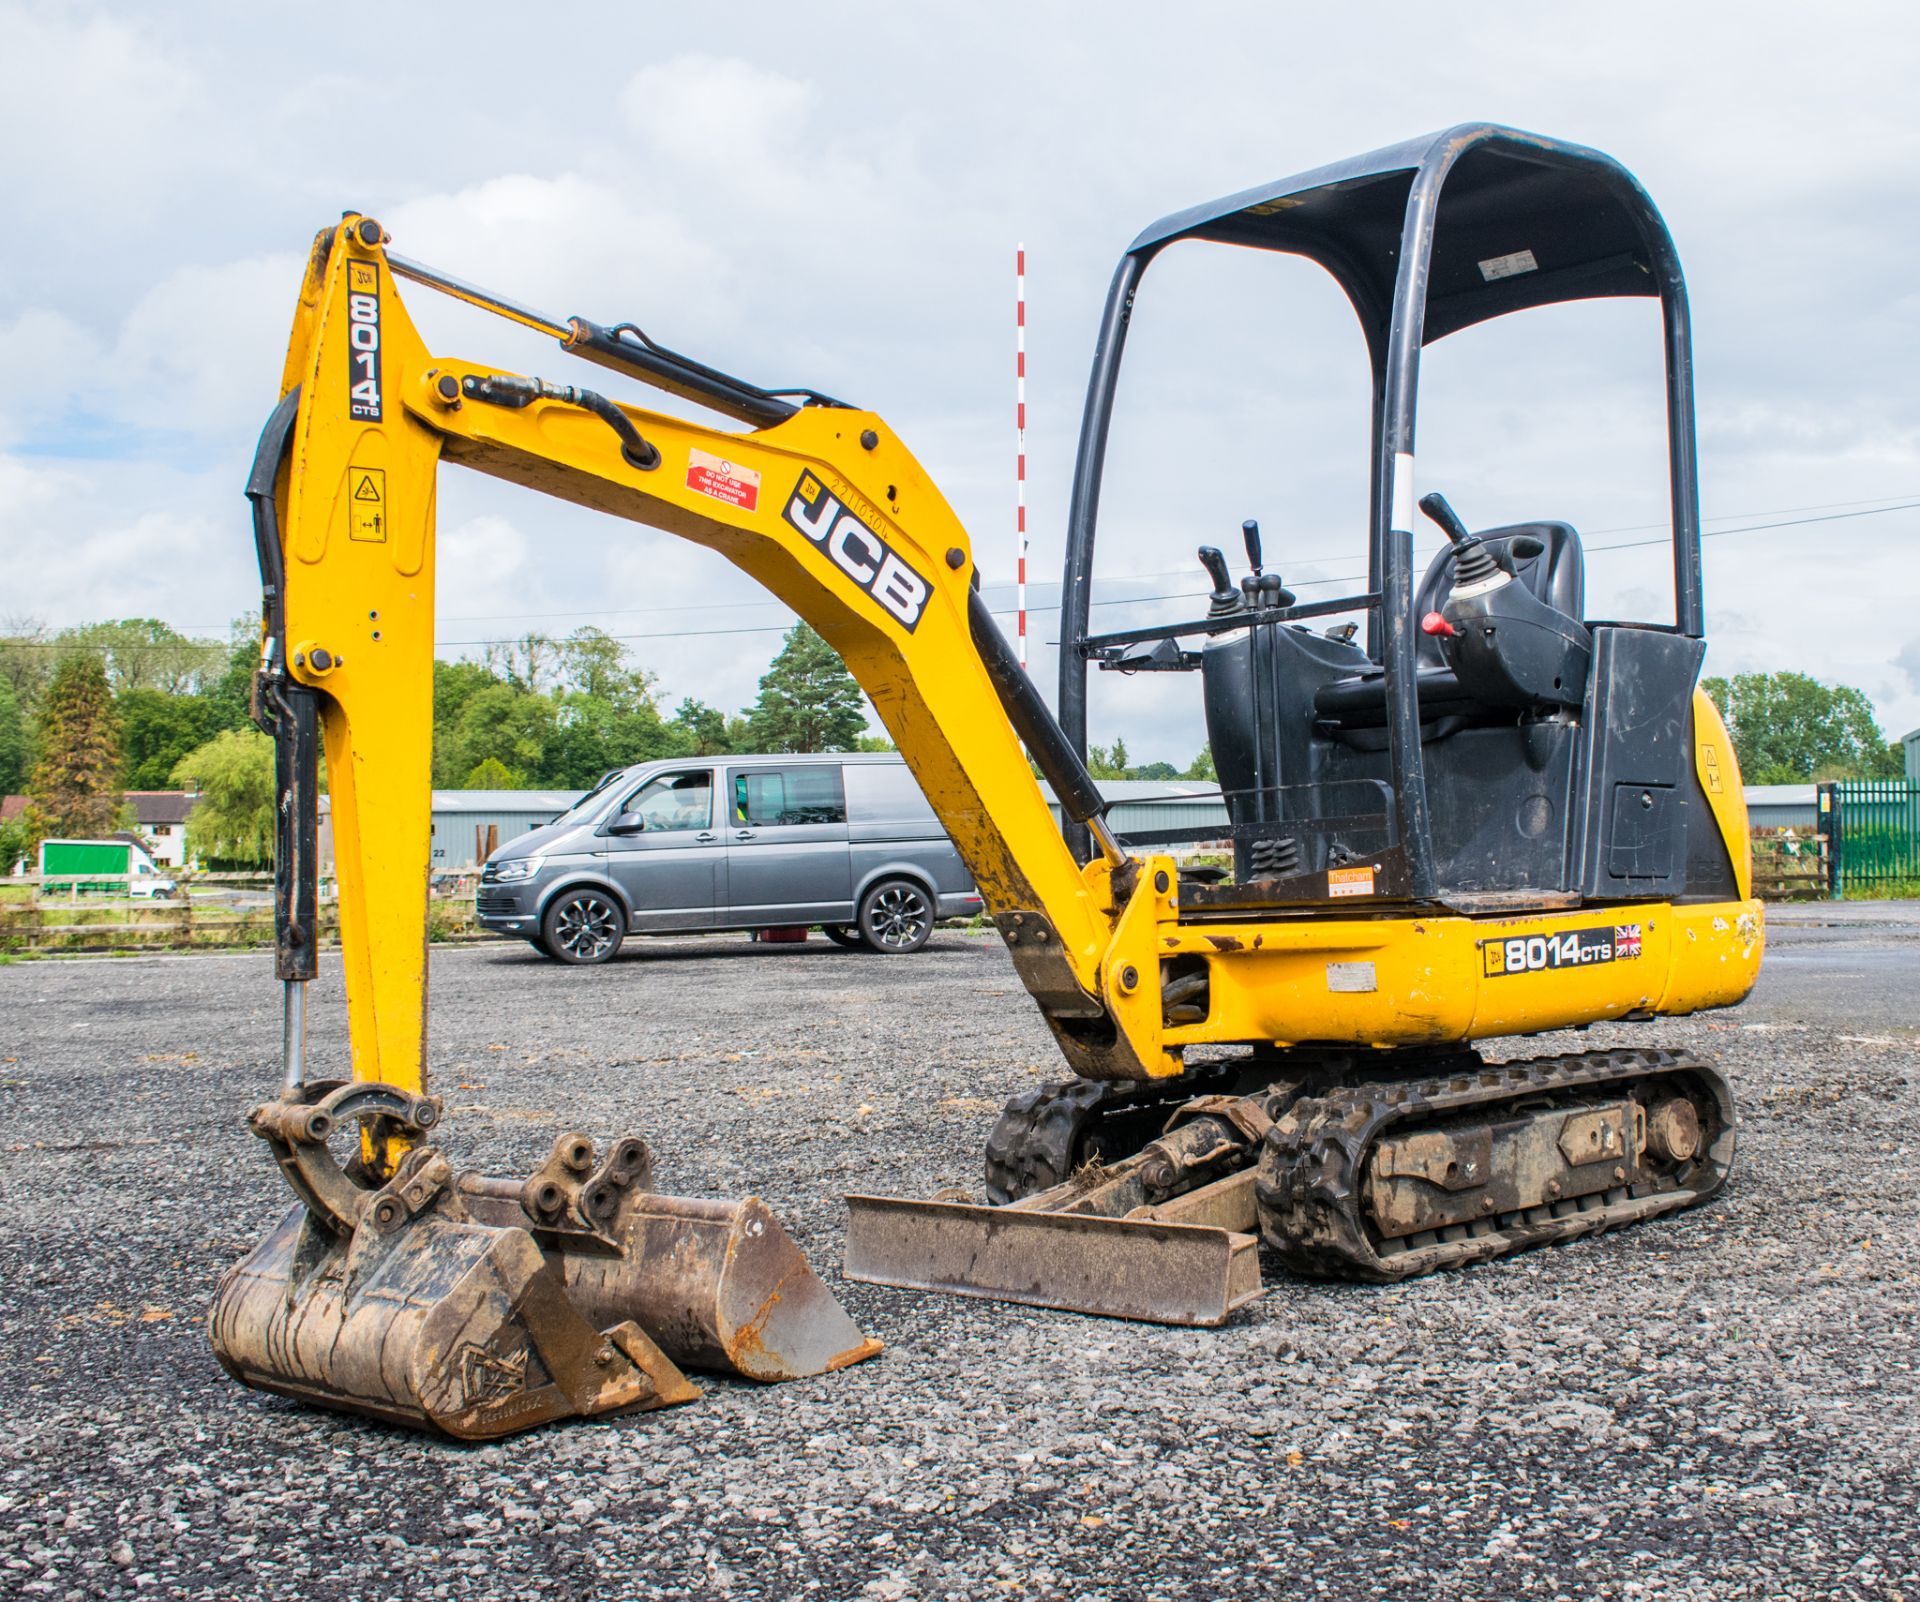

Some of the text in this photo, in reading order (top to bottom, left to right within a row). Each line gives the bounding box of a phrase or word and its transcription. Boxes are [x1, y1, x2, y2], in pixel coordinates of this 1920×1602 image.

[350, 294, 379, 406] 8014
[352, 405, 380, 418] CTS
[698, 475, 747, 499] THIS EXCAVATOR
[705, 470, 741, 488] DO NOT USE
[704, 486, 712, 495] AS
[718, 492, 739, 504] CRANE
[790, 496, 926, 625] JCB
[433, 849, 445, 858] 22
[1330, 871, 1371, 884] Thatcham
